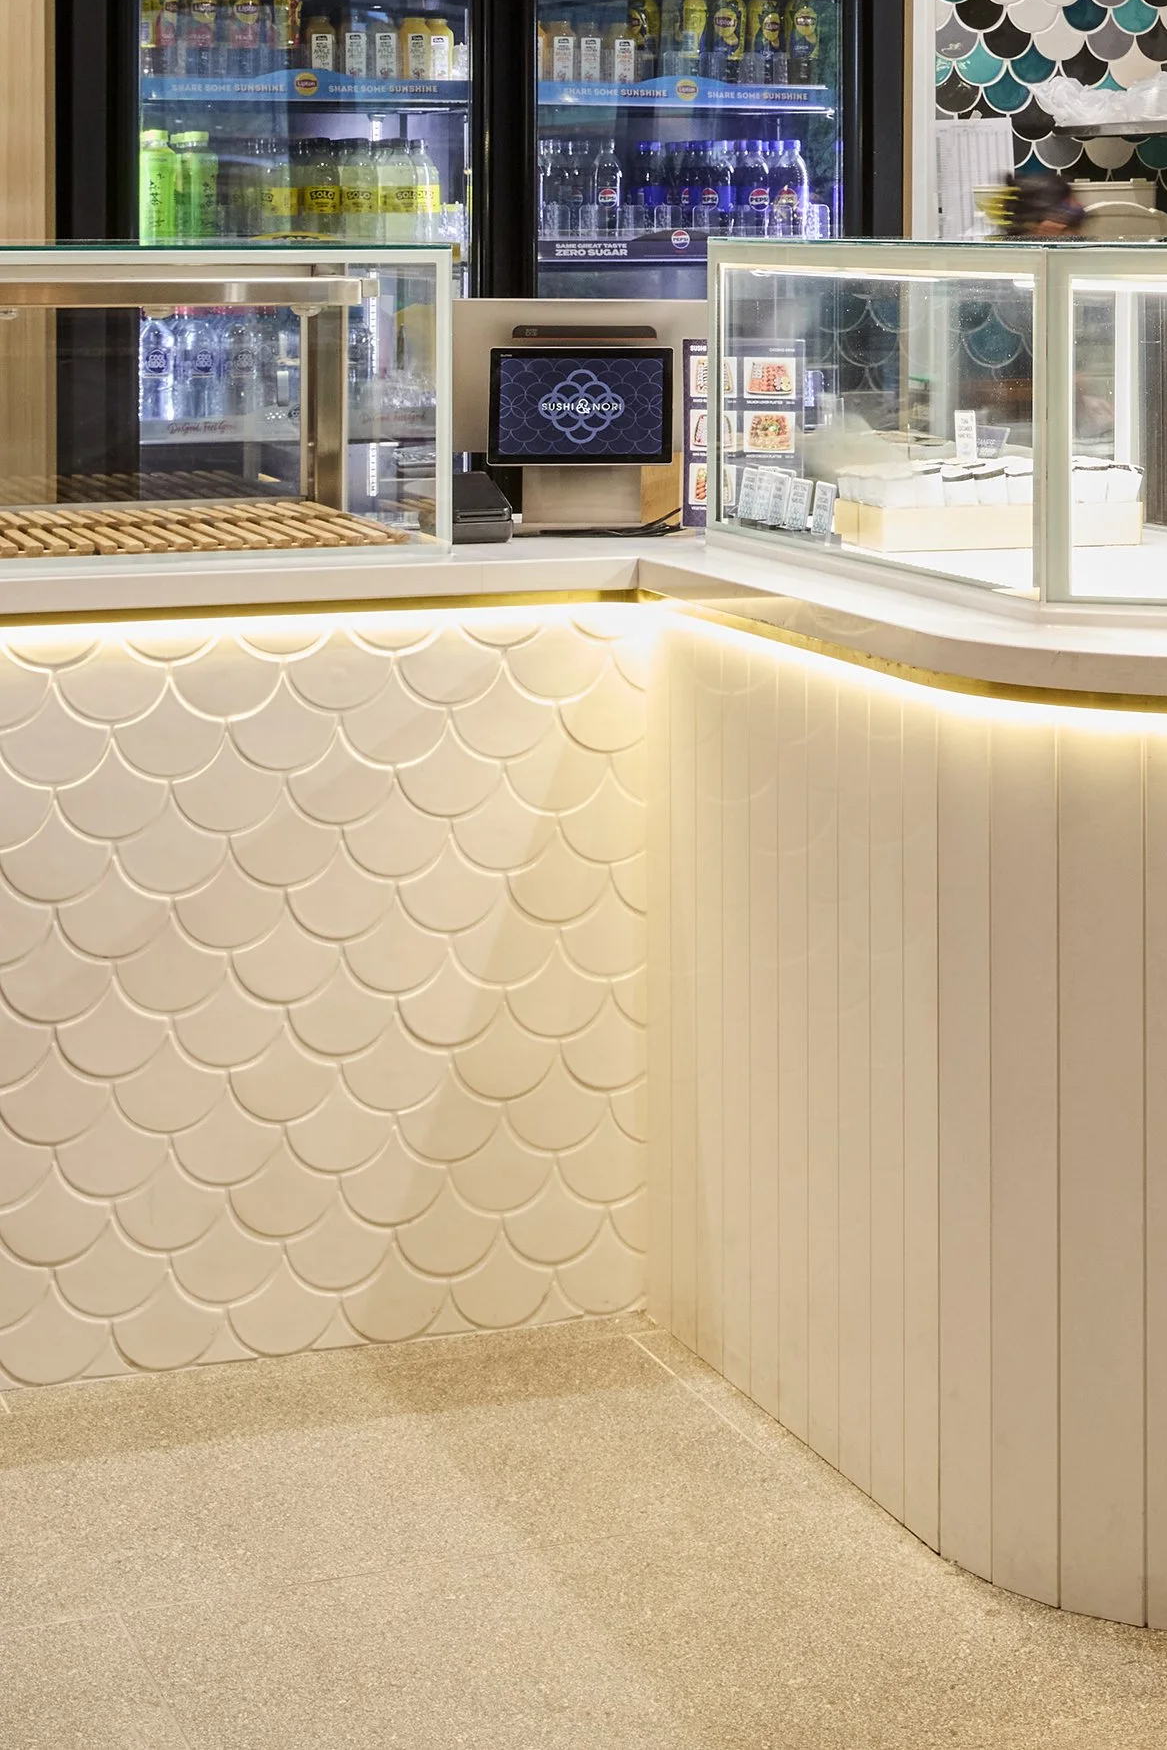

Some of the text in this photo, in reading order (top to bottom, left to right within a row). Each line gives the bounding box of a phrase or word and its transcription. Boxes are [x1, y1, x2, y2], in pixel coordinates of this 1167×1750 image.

[172, 84, 285, 93] SHARE SOME SUNSHINE
[297, 80, 316, 88] Lipton
[329, 85, 438, 94] SHARE SOME SUNSHINE
[563, 88, 668, 98] SHARE SOME SUNSHINE
[708, 91, 808, 100] SHARE SOME SUNSHINE
[310, 190, 335, 201] SOLO
[347, 190, 371, 201] SOLO
[541, 398, 622, 415] SUSHI & NORI
